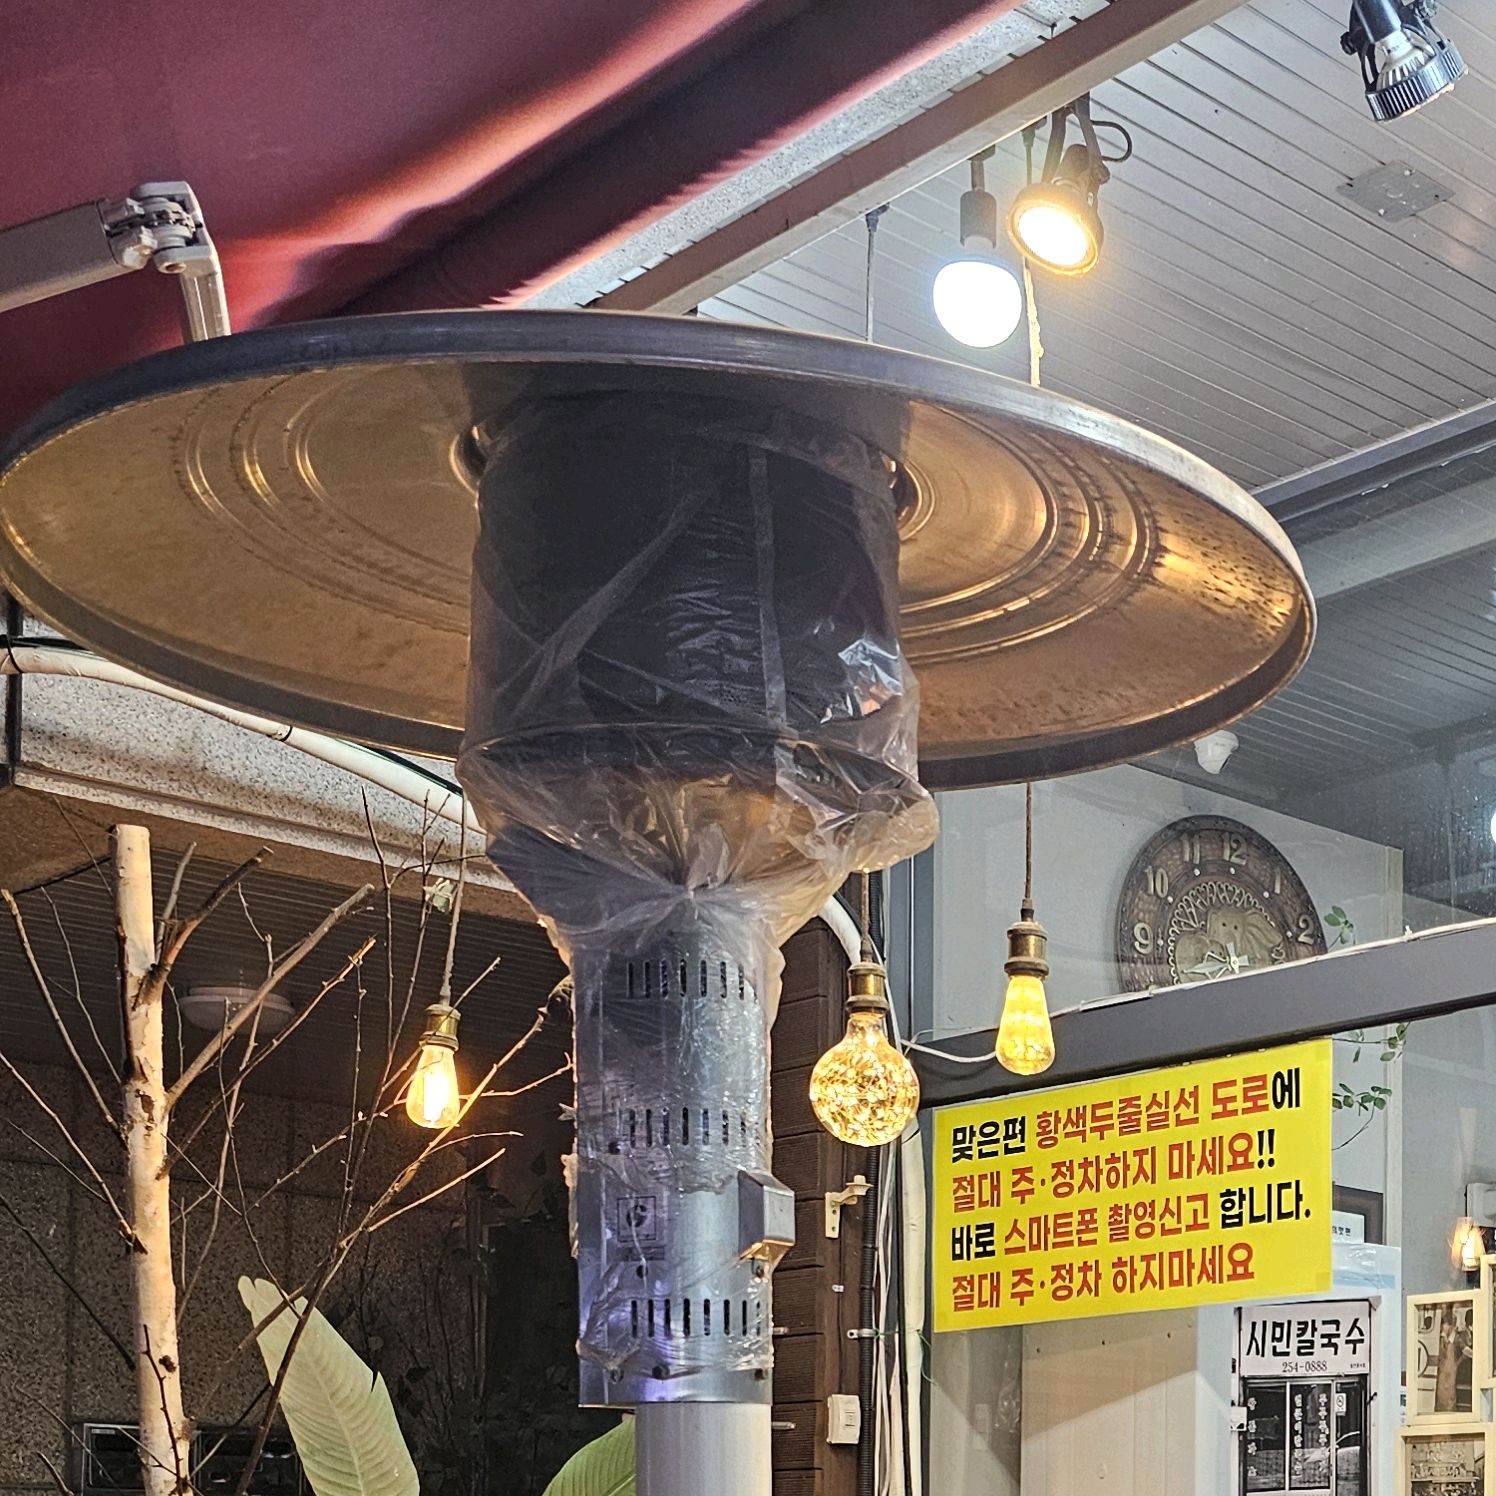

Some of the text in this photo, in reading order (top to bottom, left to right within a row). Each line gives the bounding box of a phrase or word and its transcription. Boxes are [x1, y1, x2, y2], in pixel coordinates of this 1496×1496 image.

[1222, 832, 1246, 865] 12
[1146, 865, 1168, 898] 10
[1133, 922, 1153, 954] 9
[1298, 915, 1314, 945] 2
[951, 1067, 1302, 1164] 맞은편 황색두줄실선 도로에
[951, 1128, 1275, 1213] 절대 주·정차하지 마세요!!
[951, 1179, 1312, 1261] 바로 스마트폰 촬영신고 합니다.
[951, 1242, 1255, 1313] 절대 주·정차 하지마세요
[1246, 1318, 1365, 1358] 시민칼국수
[1282, 1361, 1327, 1373] 254-0888
